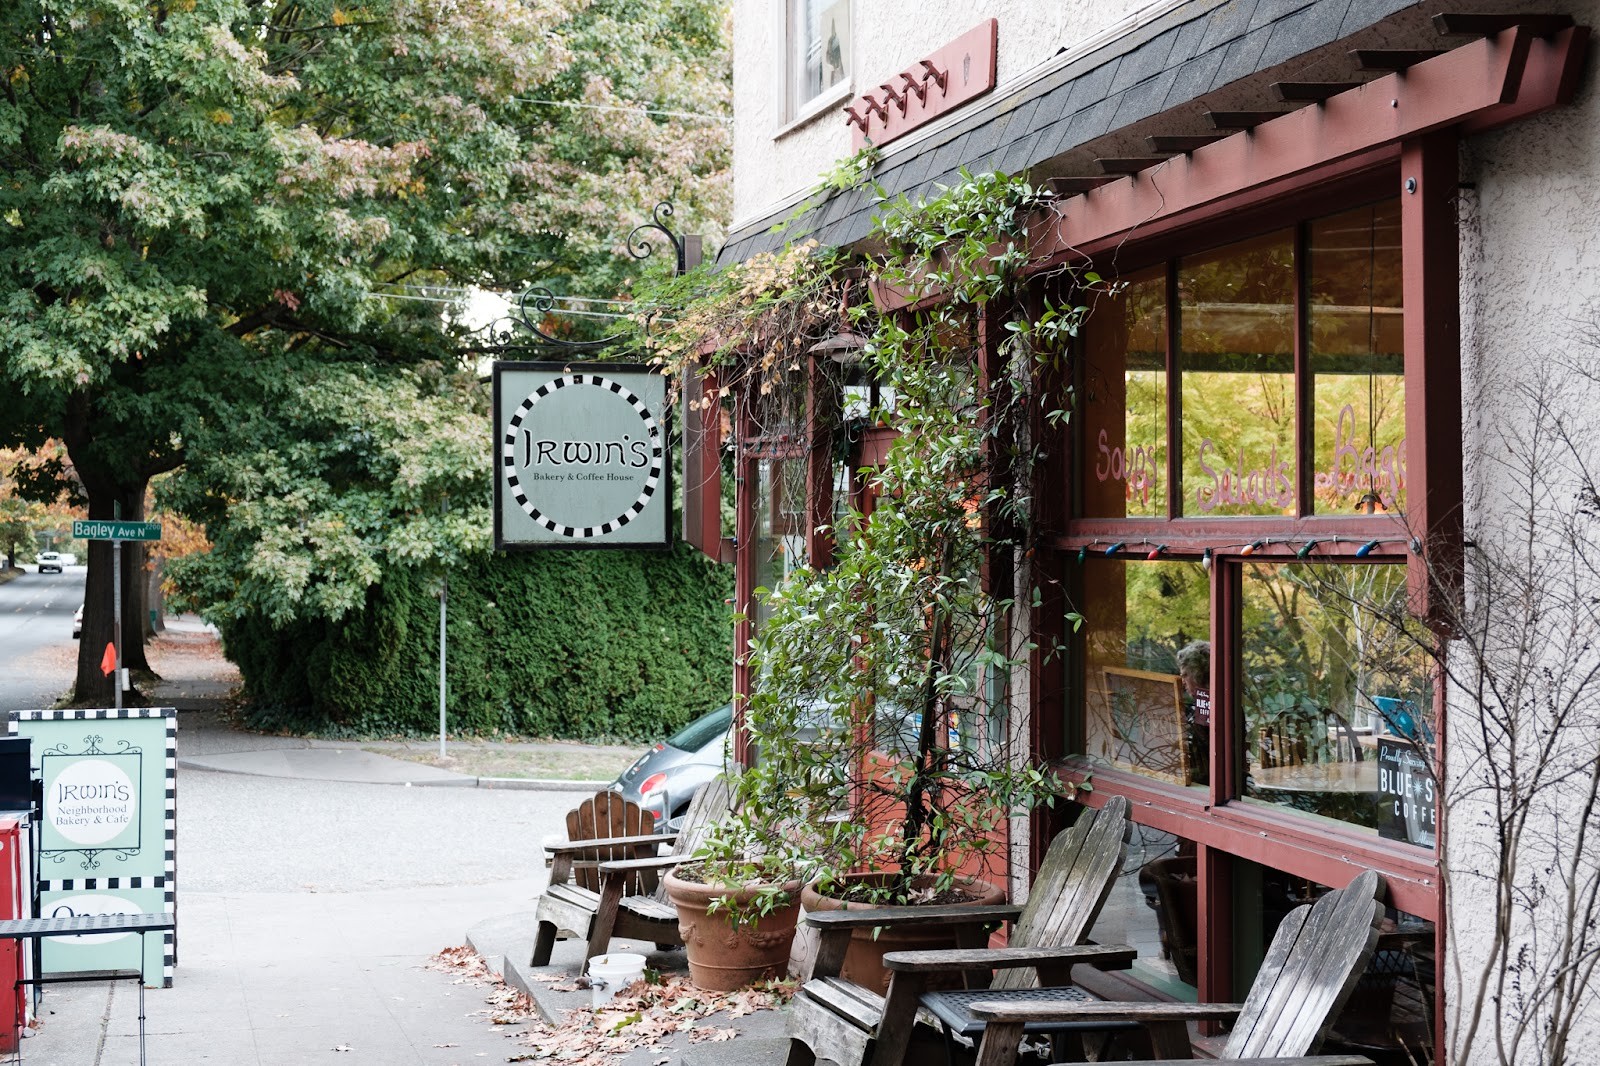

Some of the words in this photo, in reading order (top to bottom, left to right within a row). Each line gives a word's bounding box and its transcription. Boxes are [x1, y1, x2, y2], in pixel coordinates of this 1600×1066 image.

[1096, 429, 1157, 498] Soups
[1196, 438, 1292, 512] Salads
[533, 472, 565, 483] Bakery
[567, 472, 575, 481] &
[576, 472, 605, 481] Coffee
[606, 473, 634, 481] House
[74, 522, 115, 538] Bagley
[117, 527, 136, 537] Ave
[137, 528, 145, 537] N
[144, 523, 161, 531] 2200
[1380, 768, 1412, 798] BLUE
[58, 804, 127, 817] Neighborhood
[56, 816, 90, 827] Bakery
[93, 815, 102, 825] &
[106, 814, 129, 824] Cafe
